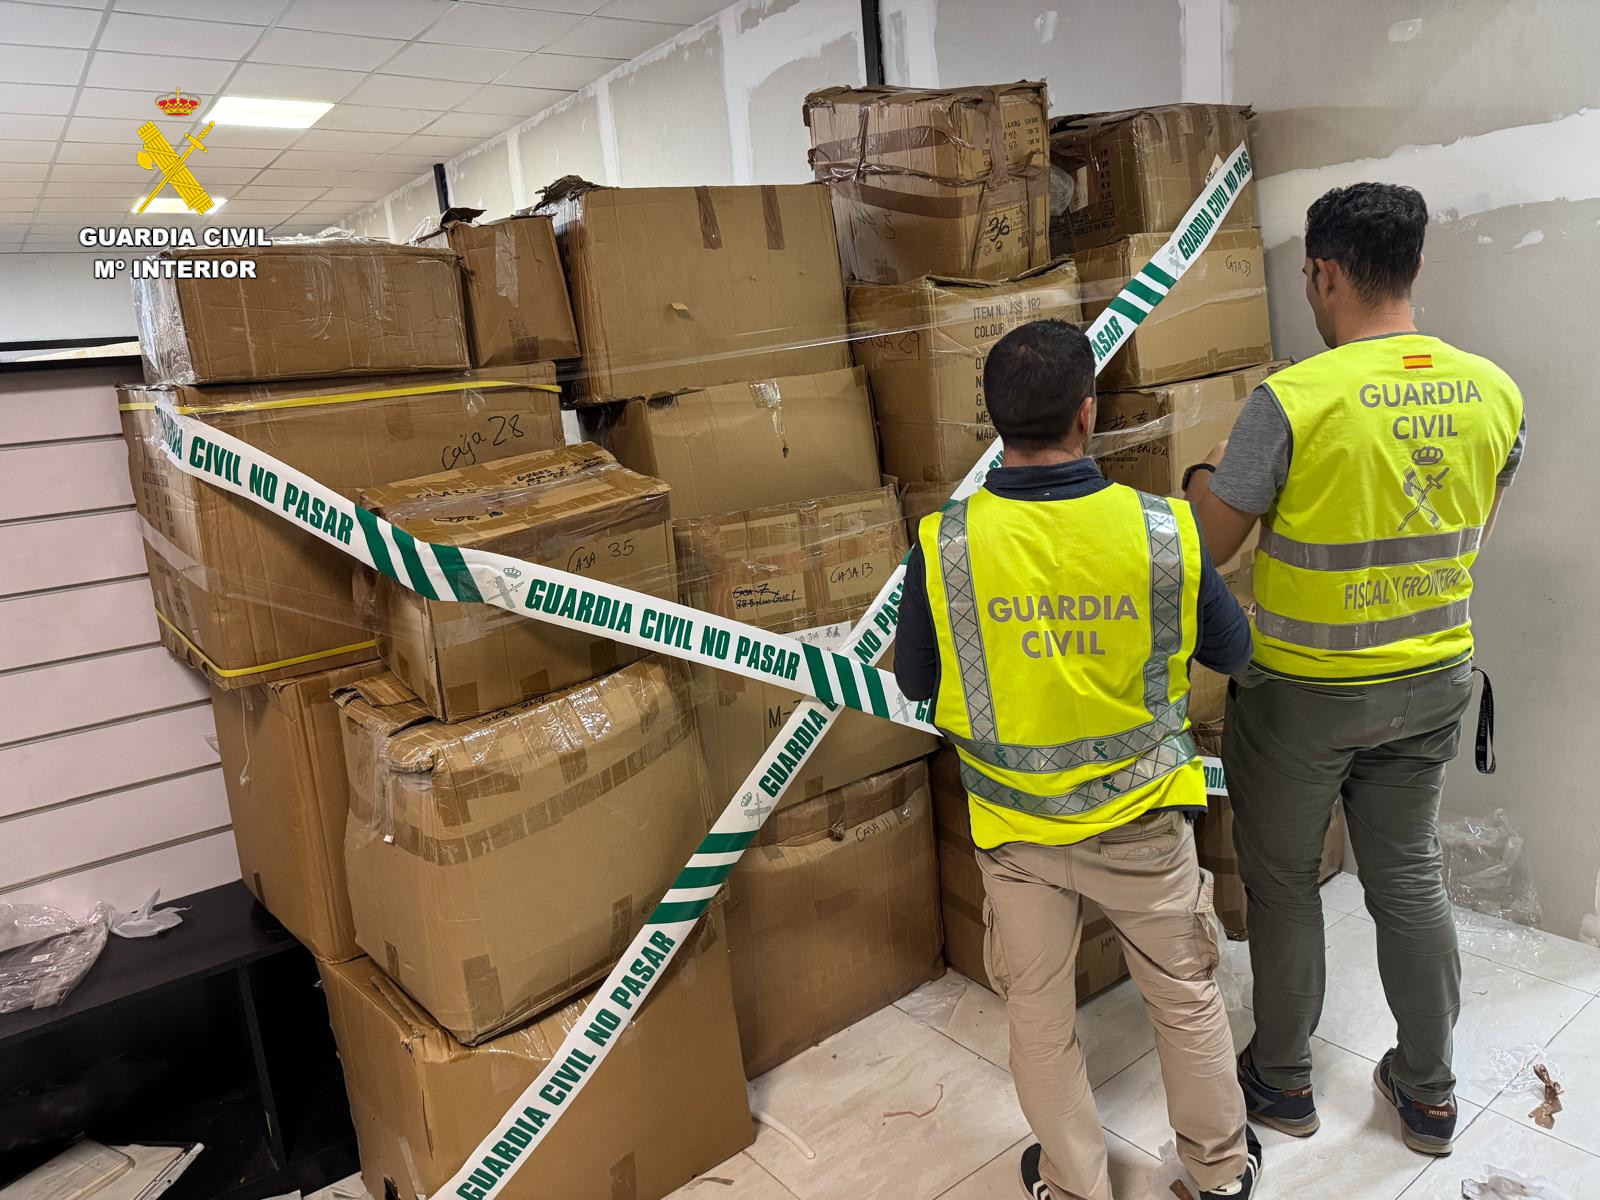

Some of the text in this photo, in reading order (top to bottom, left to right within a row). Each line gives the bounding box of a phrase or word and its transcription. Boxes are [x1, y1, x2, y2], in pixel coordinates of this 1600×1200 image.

[988, 215, 1011, 242] 36
[1177, 208, 1215, 261] GUARDIA
[1206, 184, 1230, 219] CIVIL
[1223, 169, 1239, 196] NO
[973, 304, 994, 321] ITEM
[1091, 314, 1125, 362] ASAR
[1359, 379, 1483, 408] GUARDIA
[488, 414, 525, 446] 28
[1392, 413, 1458, 440] CIVIL
[189, 436, 242, 486] CIVIL
[249, 463, 279, 502] NO
[283, 482, 354, 546] PASAR
[608, 538, 635, 558] 35
[861, 562, 874, 578] 13
[987, 594, 1139, 622] GUARDIA
[1344, 580, 1390, 610] FISCAL
[1392, 577, 1401, 603] Y
[524, 578, 801, 682] GUARDIA CIVIL NO PASAR
[853, 582, 904, 665] NO PAS
[1021, 630, 1106, 659] CIVIL
[758, 708, 828, 798] GUARDIA
[456, 930, 676, 1200] GUARDIA CIVIL NO PASAR
